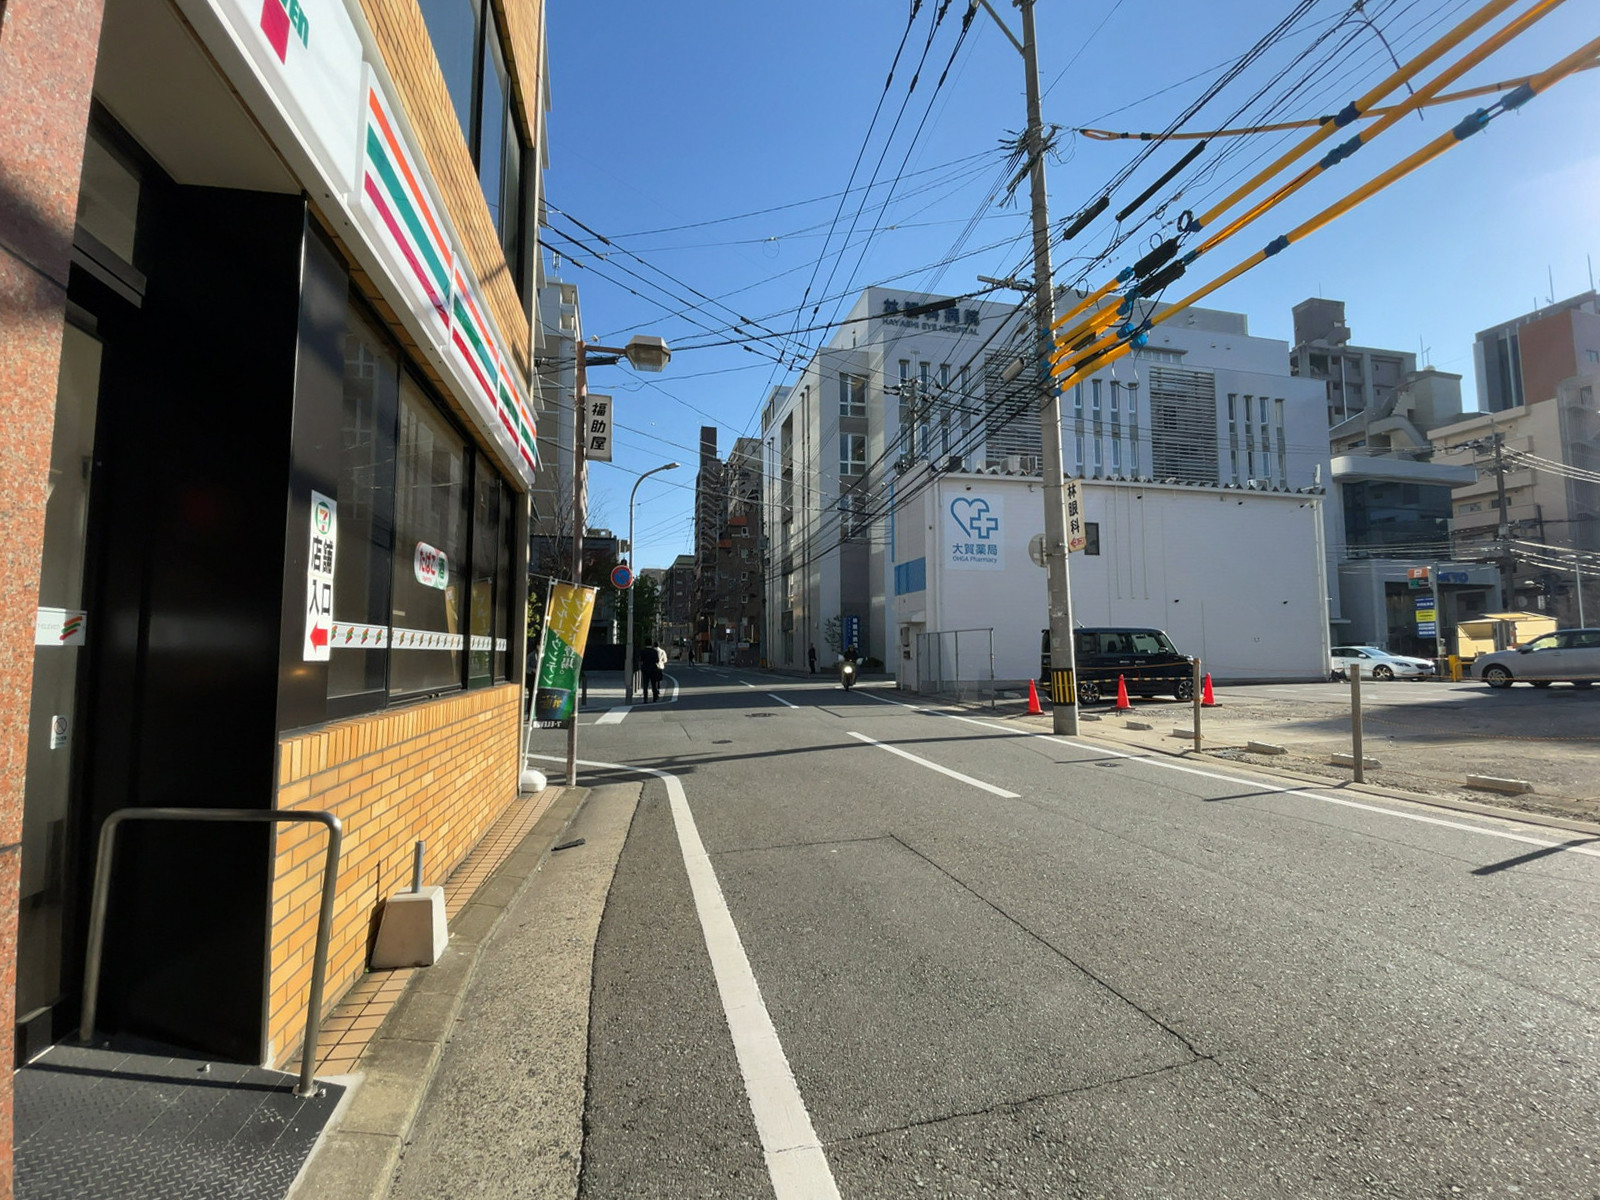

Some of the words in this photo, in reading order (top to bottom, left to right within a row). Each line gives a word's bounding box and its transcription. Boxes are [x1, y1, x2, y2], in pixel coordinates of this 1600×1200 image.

[590, 402, 608, 451] 福助屋
[1067, 482, 1080, 534] 林眼科
[312, 535, 334, 575] 店舗
[952, 543, 998, 556] 大賀薬局
[970, 556, 998, 564] Pharmacy
[309, 579, 332, 617] 入口
